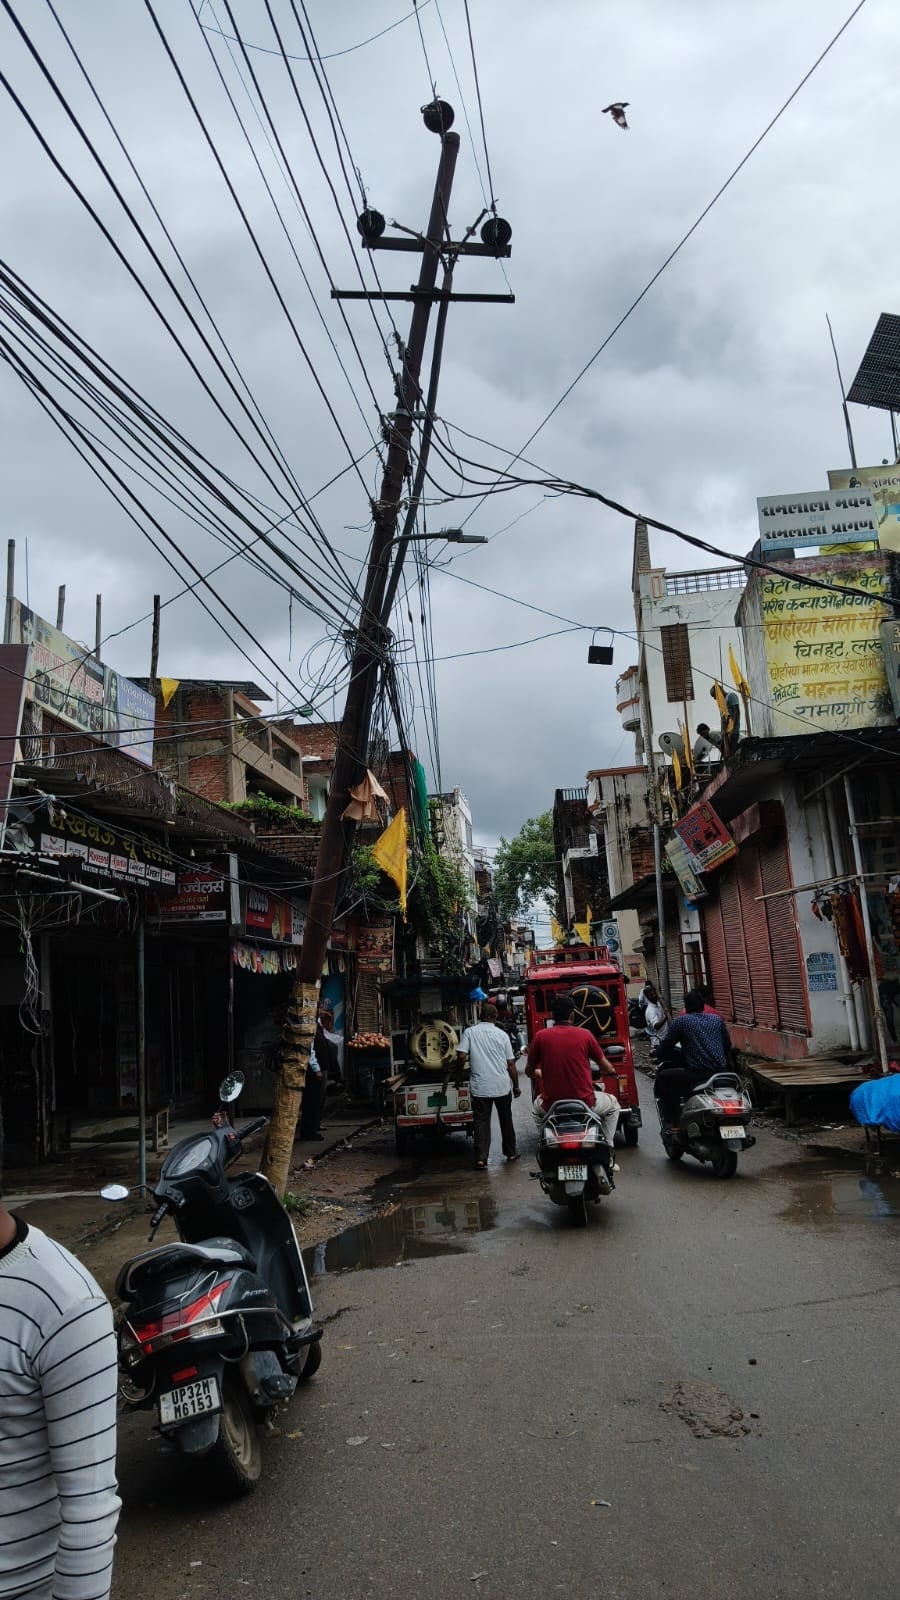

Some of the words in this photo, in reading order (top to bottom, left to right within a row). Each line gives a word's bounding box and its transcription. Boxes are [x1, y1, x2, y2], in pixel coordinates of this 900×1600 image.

[764, 579, 791, 595] बेटी
[860, 571, 883, 588] बेटी
[762, 599, 785, 615] गरीब
